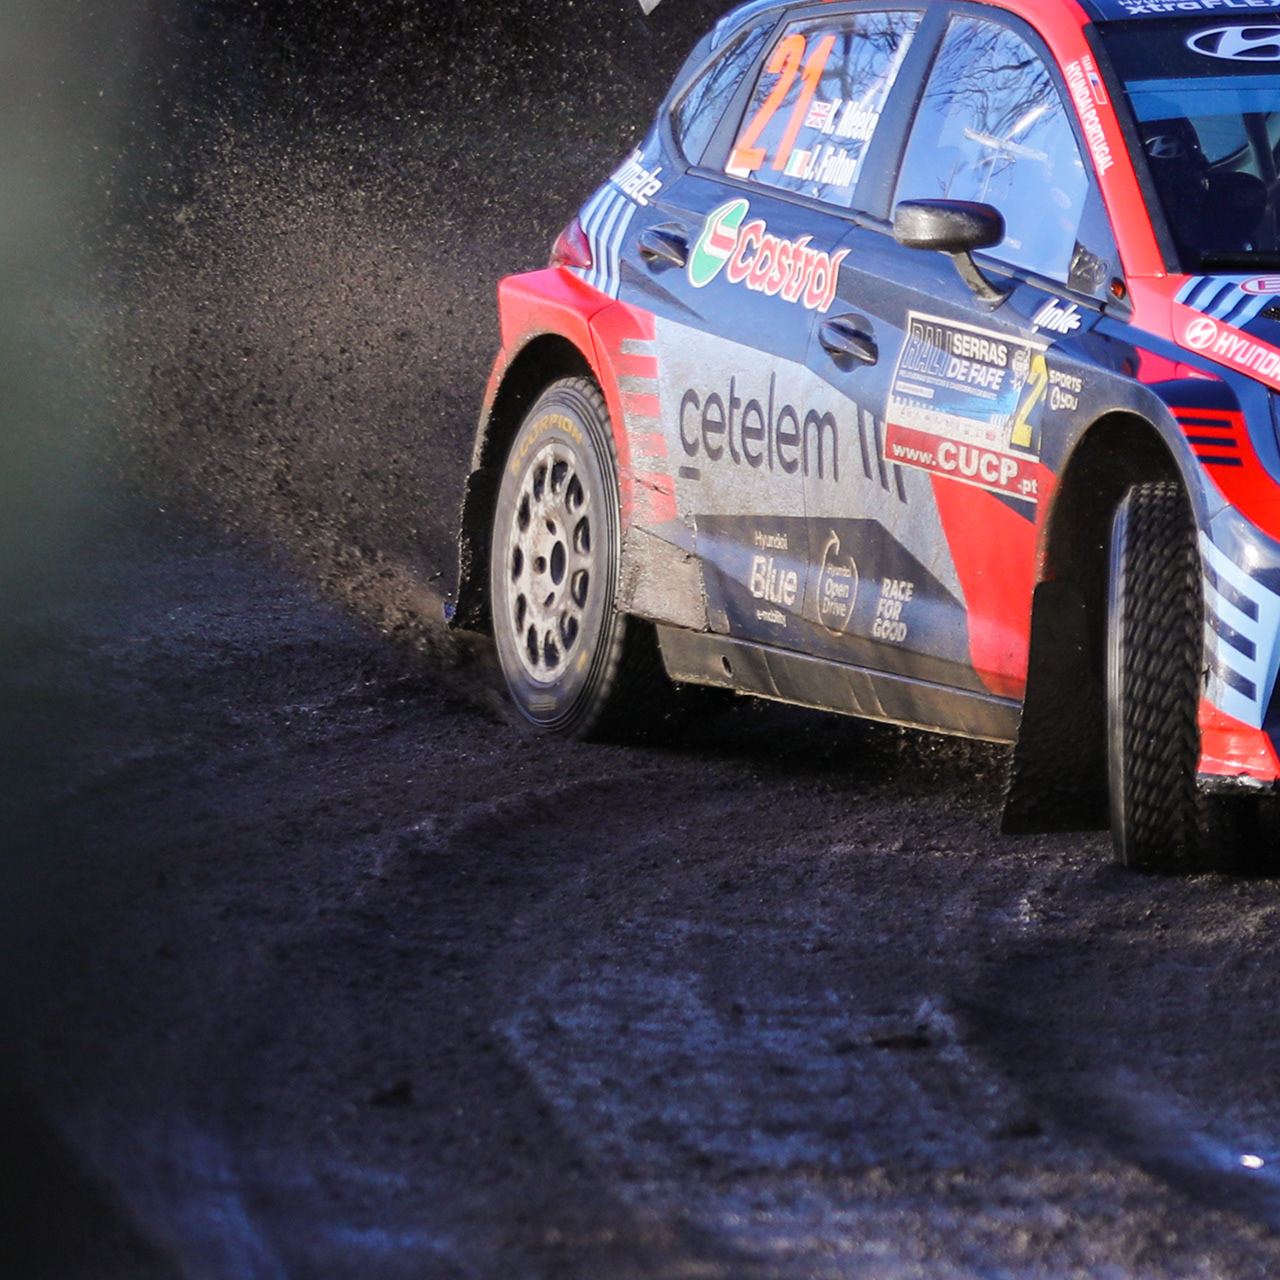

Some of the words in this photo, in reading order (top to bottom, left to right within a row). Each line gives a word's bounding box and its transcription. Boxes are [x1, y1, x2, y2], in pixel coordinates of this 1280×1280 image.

[728, 33, 837, 172] 21
[1065, 60, 1094, 115] HYUNDAI
[1082, 109, 1115, 176] PORTUGAL
[814, 146, 857, 187] Fulton
[726, 219, 852, 313] Castrol
[952, 335, 1008, 367] SERRAS
[947, 358, 969, 383] DE
[967, 363, 1005, 391] FAFE
[1049, 370, 1082, 393] SPORTS
[1011, 354, 1048, 448] 2
[750, 554, 798, 606] Blue
[825, 578, 850, 598] Open
[881, 577, 914, 602] RACE
[821, 597, 848, 617] Drive
[876, 598, 903, 620] FOR
[872, 618, 908, 642] GOOD
